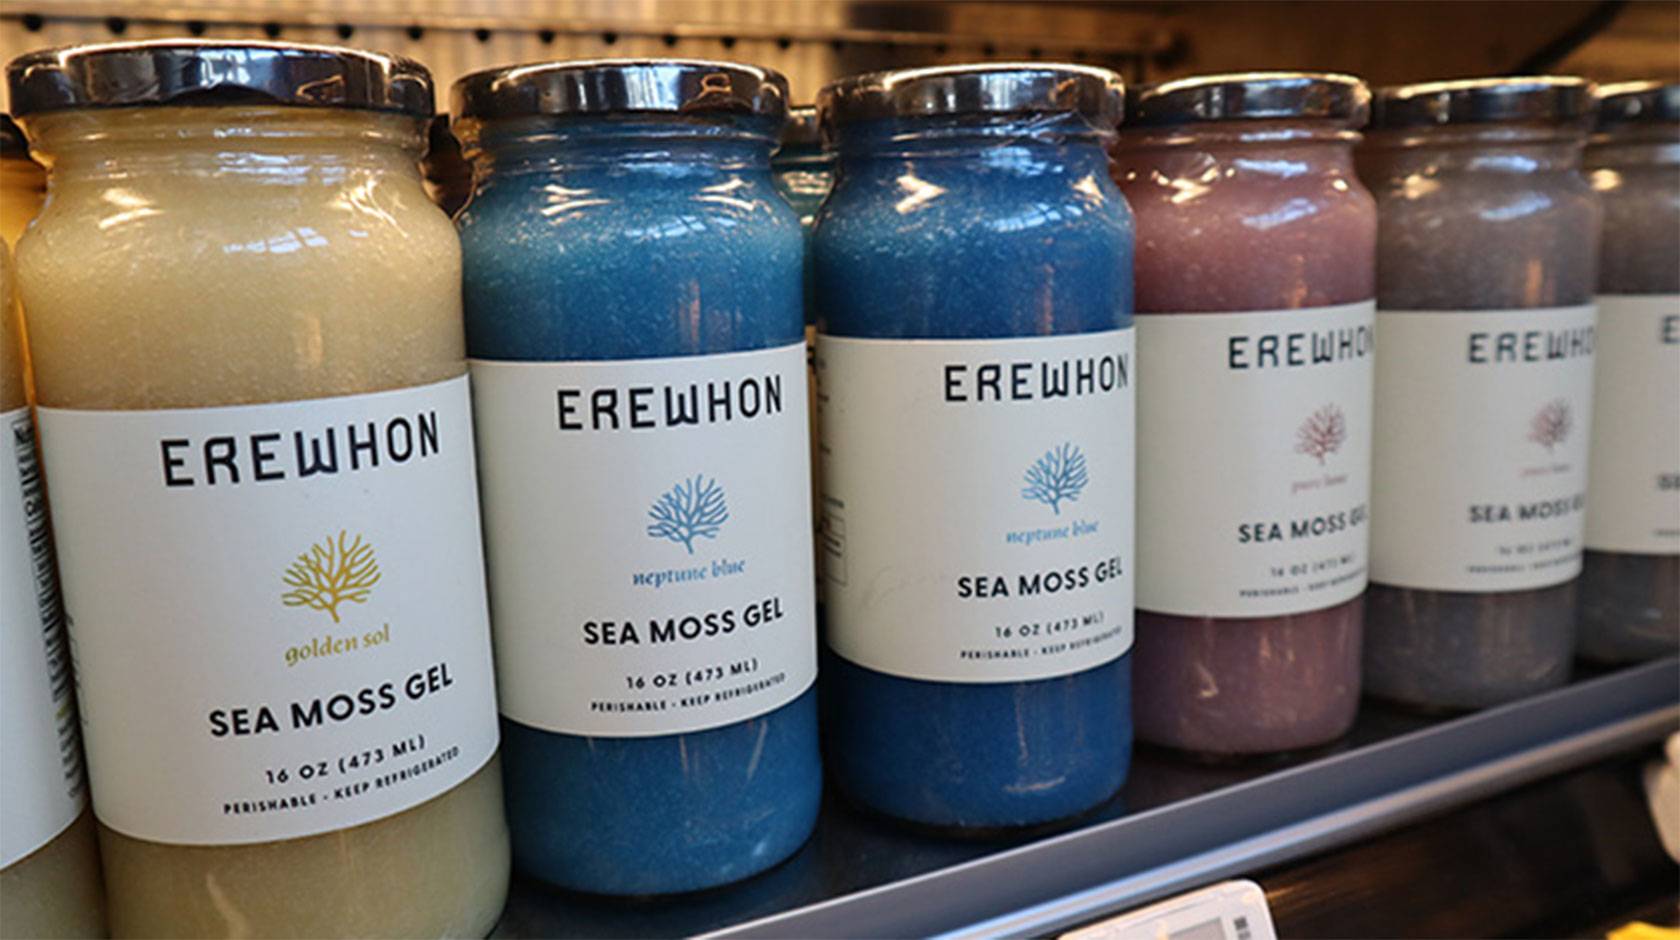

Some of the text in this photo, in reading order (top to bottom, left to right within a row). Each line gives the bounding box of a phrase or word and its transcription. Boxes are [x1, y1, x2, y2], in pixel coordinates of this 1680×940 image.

[944, 352, 1129, 402] EREWHON
[557, 375, 782, 430] EREWHON
[160, 411, 440, 487] EREWHON
[1238, 522, 1282, 543] SEA
[1291, 511, 1346, 539] MOSS
[1469, 504, 1511, 523] SEA
[1006, 527, 1069, 545] neptune
[632, 558, 745, 588] neptune blue
[957, 556, 1122, 599] SEA MOSS GEL
[583, 597, 784, 645] SEA MOSS GEL
[996, 626, 1011, 638] 16
[1019, 624, 1040, 636] OZ
[1046, 618, 1078, 634] (473
[284, 623, 390, 667] golden sol
[961, 648, 1029, 660] PERISHABLE
[591, 700, 666, 712] PERISHABLE
[681, 695, 710, 708] KEEP
[715, 672, 785, 701] REFRIGERATED
[626, 658, 758, 689] 16 OZ (473 ML)
[209, 663, 453, 738] SEA MOSS GEL
[224, 793, 316, 815] PERISHABLE
[334, 781, 370, 799] KEEP
[376, 746, 459, 789] REFRIGERATED
[266, 734, 425, 784] 16 OZ (473 ML)
